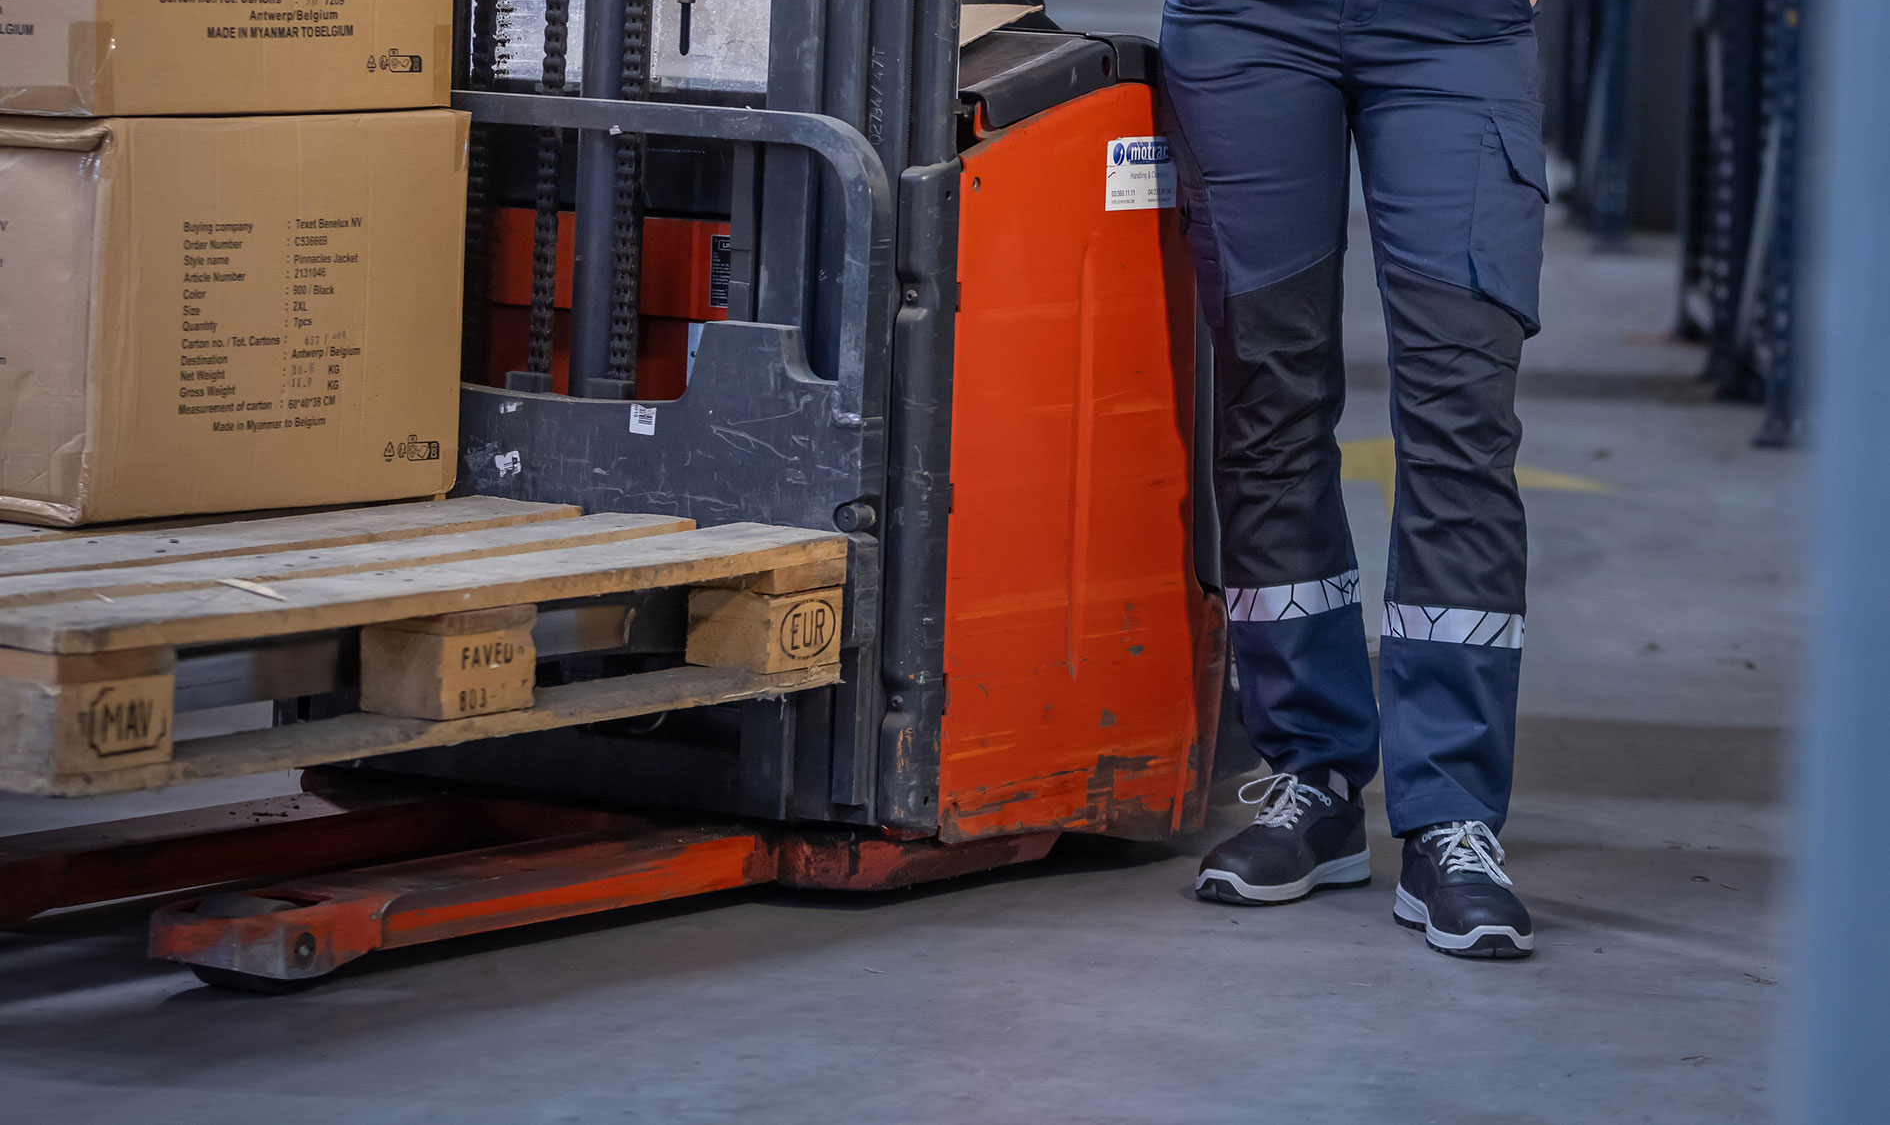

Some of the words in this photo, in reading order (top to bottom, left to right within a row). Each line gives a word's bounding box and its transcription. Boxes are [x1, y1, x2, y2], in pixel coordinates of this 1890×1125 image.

[207, 27, 236, 38] MADE
[238, 27, 248, 38] IN
[250, 26, 299, 38] MYANMAR
[1130, 144, 1169, 161] motrac
[1130, 172, 1147, 180] Handling
[184, 221, 213, 235] Buying
[215, 223, 253, 234] company
[296, 218, 317, 229] Texet
[319, 217, 349, 229] Benelux
[351, 217, 362, 227] NV
[184, 239, 208, 250] Order
[210, 239, 243, 250] Number
[184, 255, 205, 268] Style
[206, 257, 229, 265] name
[294, 254, 331, 264] Pinnacles
[333, 253, 358, 263] Jacket
[184, 272, 211, 283] Article
[213, 271, 246, 282] Number
[183, 289, 206, 300] Color
[313, 284, 335, 295] Black
[183, 305, 200, 316] Size
[293, 301, 308, 312] 2XL
[182, 321, 217, 333] Quantity
[182, 338, 209, 350] Carton
[232, 336, 246, 347] Tot.
[249, 335, 280, 346] Cartons
[181, 355, 228, 366] Destination
[291, 348, 324, 359] Antwerp
[330, 346, 361, 359] Belgium
[181, 371, 195, 381] Net
[196, 370, 225, 382] Weight
[328, 364, 340, 375] KG
[180, 387, 205, 398] Gross
[207, 385, 235, 398] Weight
[327, 380, 339, 391] KG
[179, 403, 234, 415] Measurement
[236, 401, 245, 412] of
[246, 401, 272, 411] carton
[323, 395, 336, 406] CM
[213, 421, 235, 432] Made
[236, 421, 244, 431] in
[246, 420, 282, 432] Myanmar
[284, 419, 292, 428] to
[294, 416, 326, 429] Belgium
[791, 608, 825, 650] EUR
[101, 699, 154, 743] MAV
